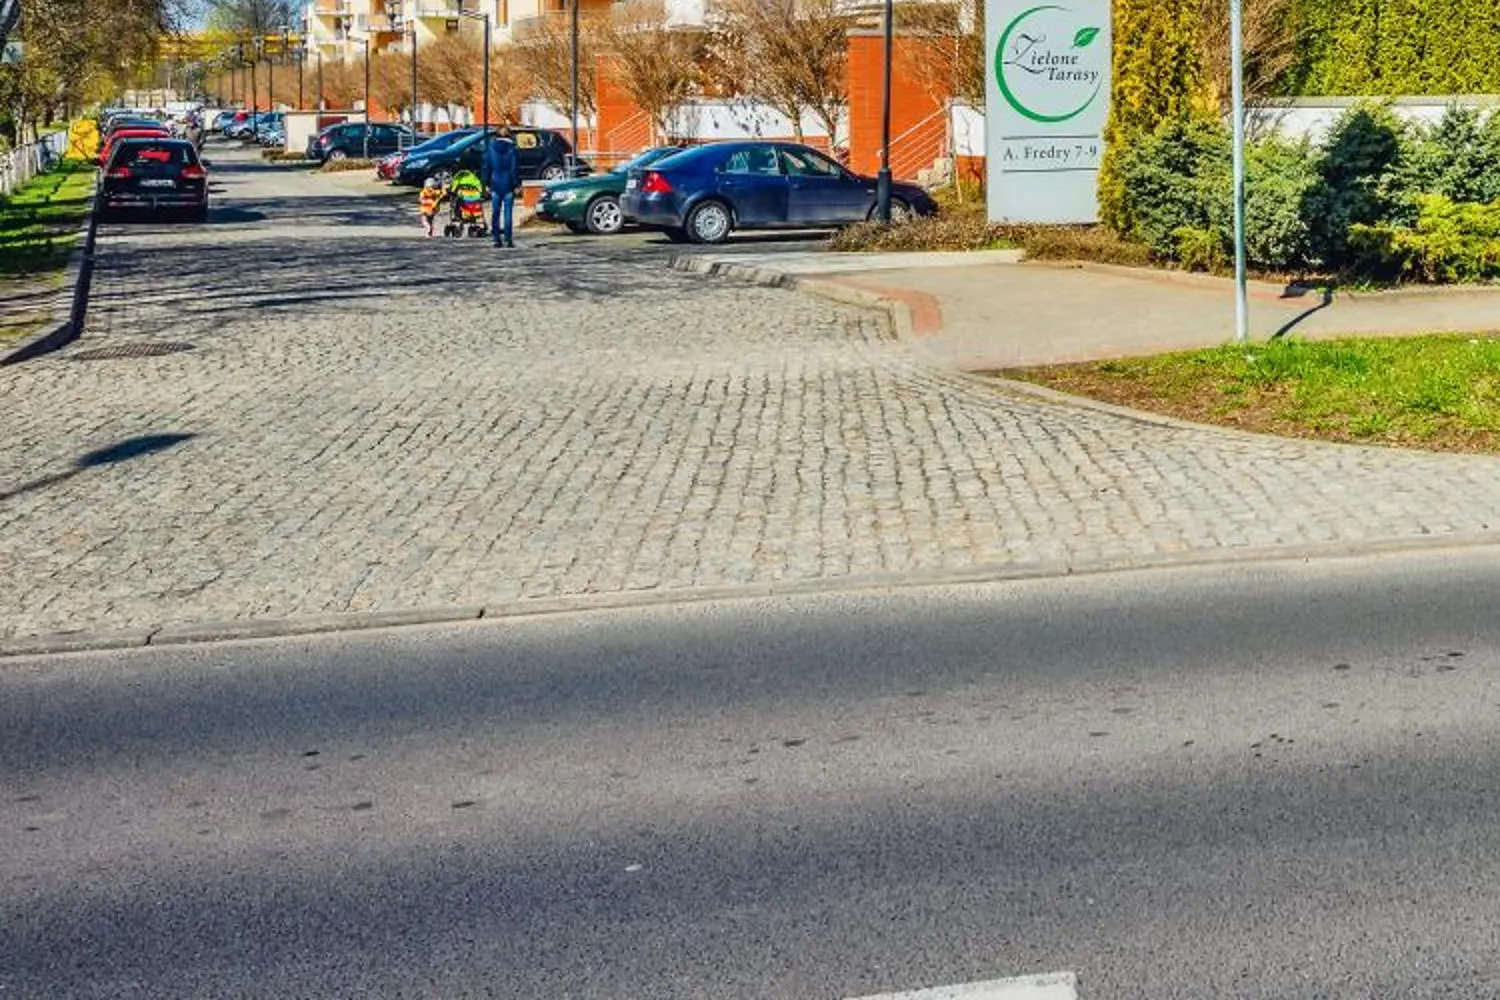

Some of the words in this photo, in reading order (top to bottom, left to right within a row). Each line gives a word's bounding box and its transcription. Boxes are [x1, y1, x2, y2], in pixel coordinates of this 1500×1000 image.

[1003, 33, 1079, 74] Zielone
[1046, 67, 1099, 84] Tarasy
[1003, 147, 1019, 161] A.
[1024, 145, 1070, 162] Fredry
[1075, 145, 1097, 160] 7-9
